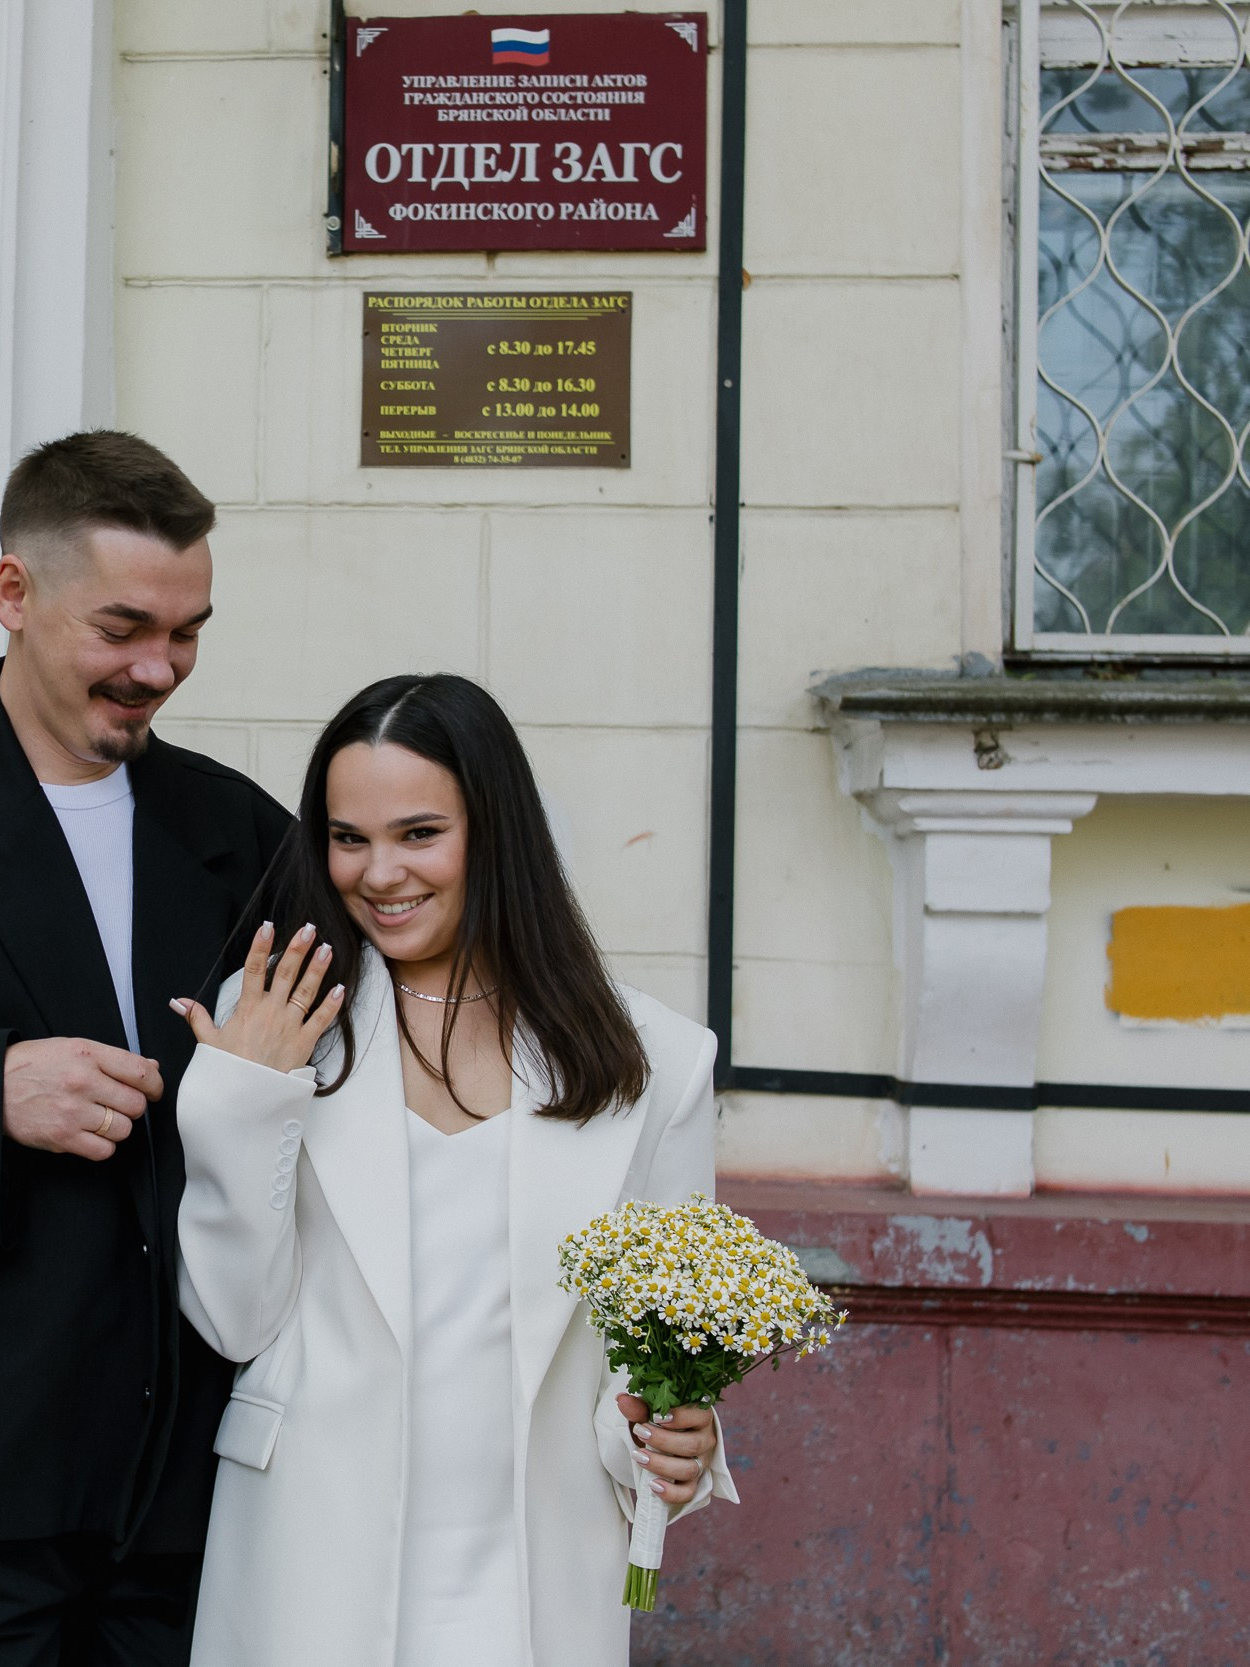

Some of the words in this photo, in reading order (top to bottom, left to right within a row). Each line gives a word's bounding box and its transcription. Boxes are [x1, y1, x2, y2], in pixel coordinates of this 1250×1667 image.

[402, 75, 516, 88] УПРАВЛЕНИЕ
[518, 75, 589, 88] ЗАПИСИ
[592, 75, 648, 88] АКТОВ
[403, 91, 539, 105] ГРАЖДАНСКОГО
[541, 91, 645, 105] СОСТОЯНИЯ
[437, 107, 528, 121] БРЯНСКОЙ
[532, 108, 611, 121] ОБЛАСТИ
[365, 143, 540, 190] ОТДЕЛ
[553, 142, 683, 184] ЗАГС
[388, 202, 554, 221] ФОКИНСКОГО
[560, 198, 659, 221] РАЙОНА
[368, 296, 463, 309] РАСПОРЯДОК
[466, 296, 526, 309] РАБОТЫ
[529, 296, 590, 309] ОТДЕЛА
[593, 296, 628, 309] ЗАГС
[381, 323, 437, 333] ВТОРНИК
[381, 335, 420, 346] СРЕДА
[381, 347, 434, 357] ЧЕТВЕРГ
[499, 341, 531, 355] 8.30
[534, 345, 552, 356] до
[557, 340, 596, 355] 17.45
[381, 359, 440, 370] ПЯТНИЦА
[380, 380, 435, 391] СУББОТА
[498, 378, 530, 392] 8.30
[533, 382, 552, 393] до
[557, 377, 596, 392] 16.30
[380, 406, 437, 416] ПЕРЕРЫВ
[495, 402, 534, 416] 13.00
[537, 406, 556, 417] до
[561, 402, 600, 417] 14.00
